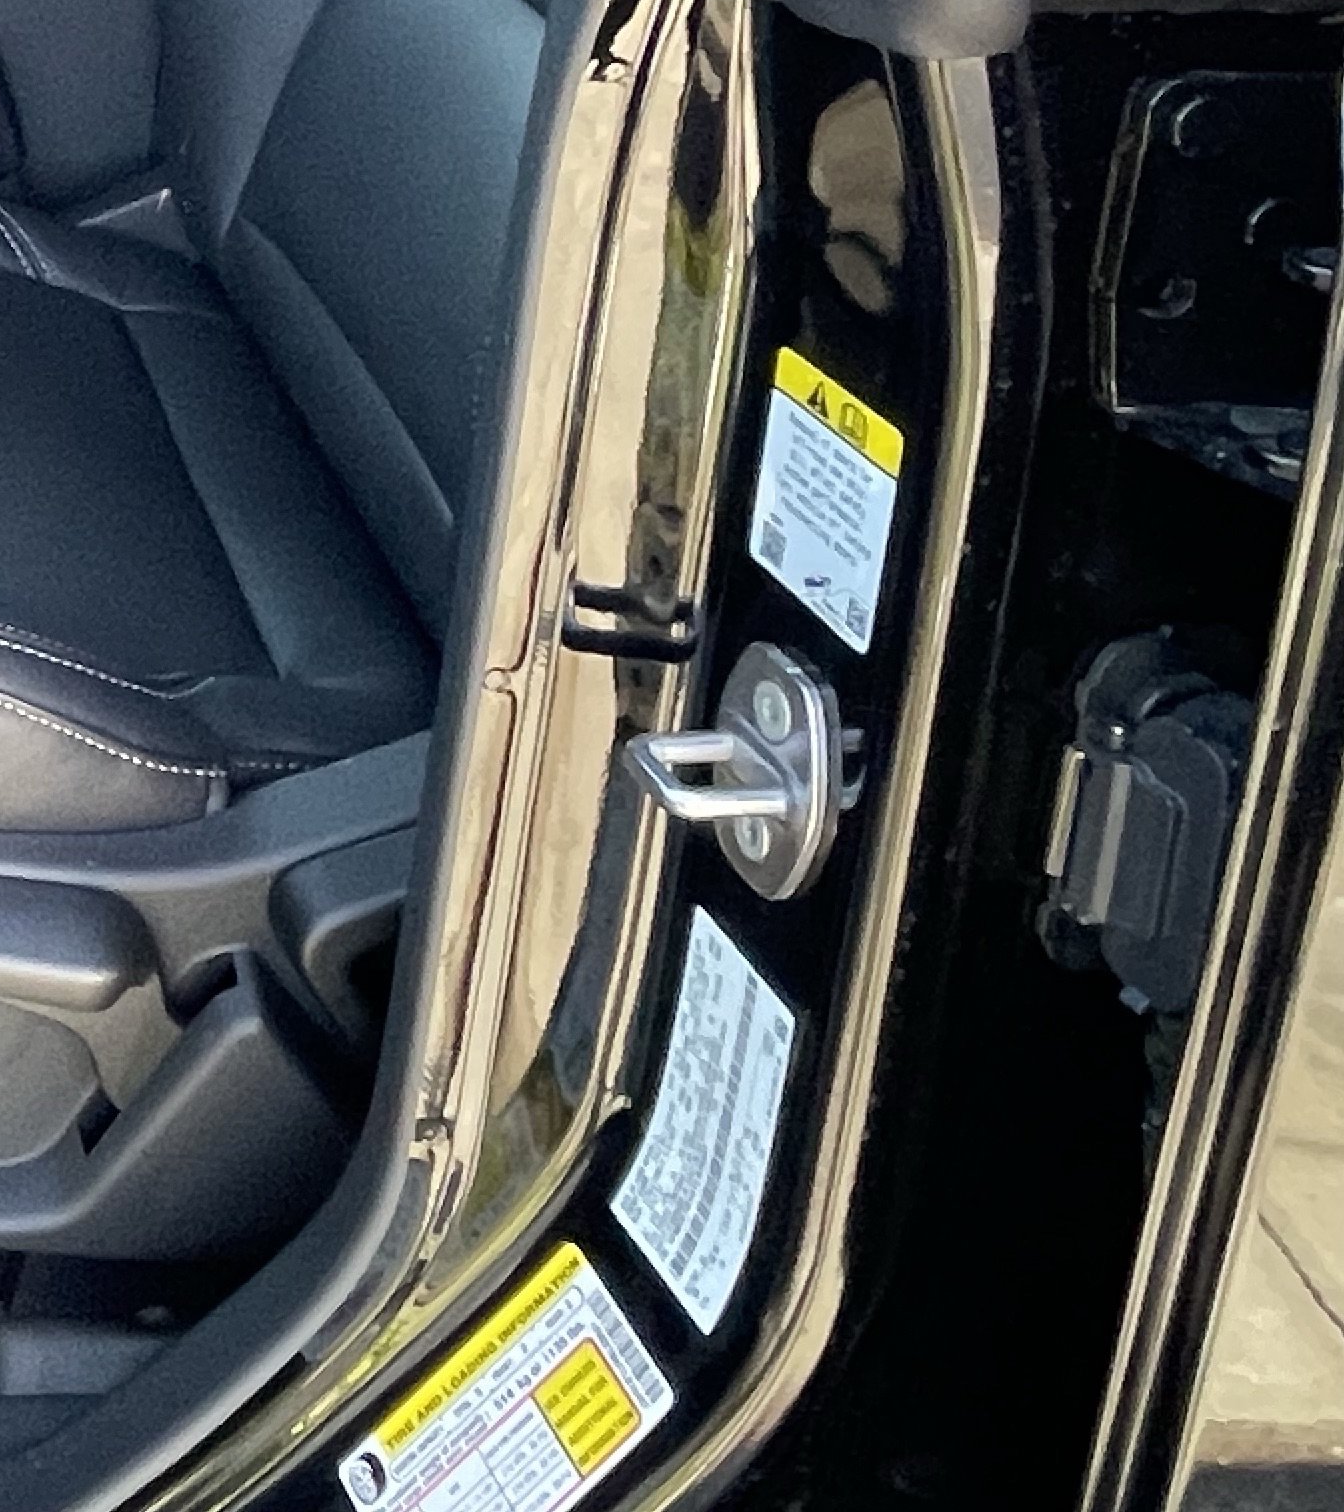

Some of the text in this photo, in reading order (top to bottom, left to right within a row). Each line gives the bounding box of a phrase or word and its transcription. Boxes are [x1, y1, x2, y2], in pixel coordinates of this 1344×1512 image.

[386, 1416, 416, 1450] TIRE
[416, 1393, 444, 1420] AND
[443, 1343, 499, 1398] LOADING
[497, 1256, 581, 1342] INFORMATION
